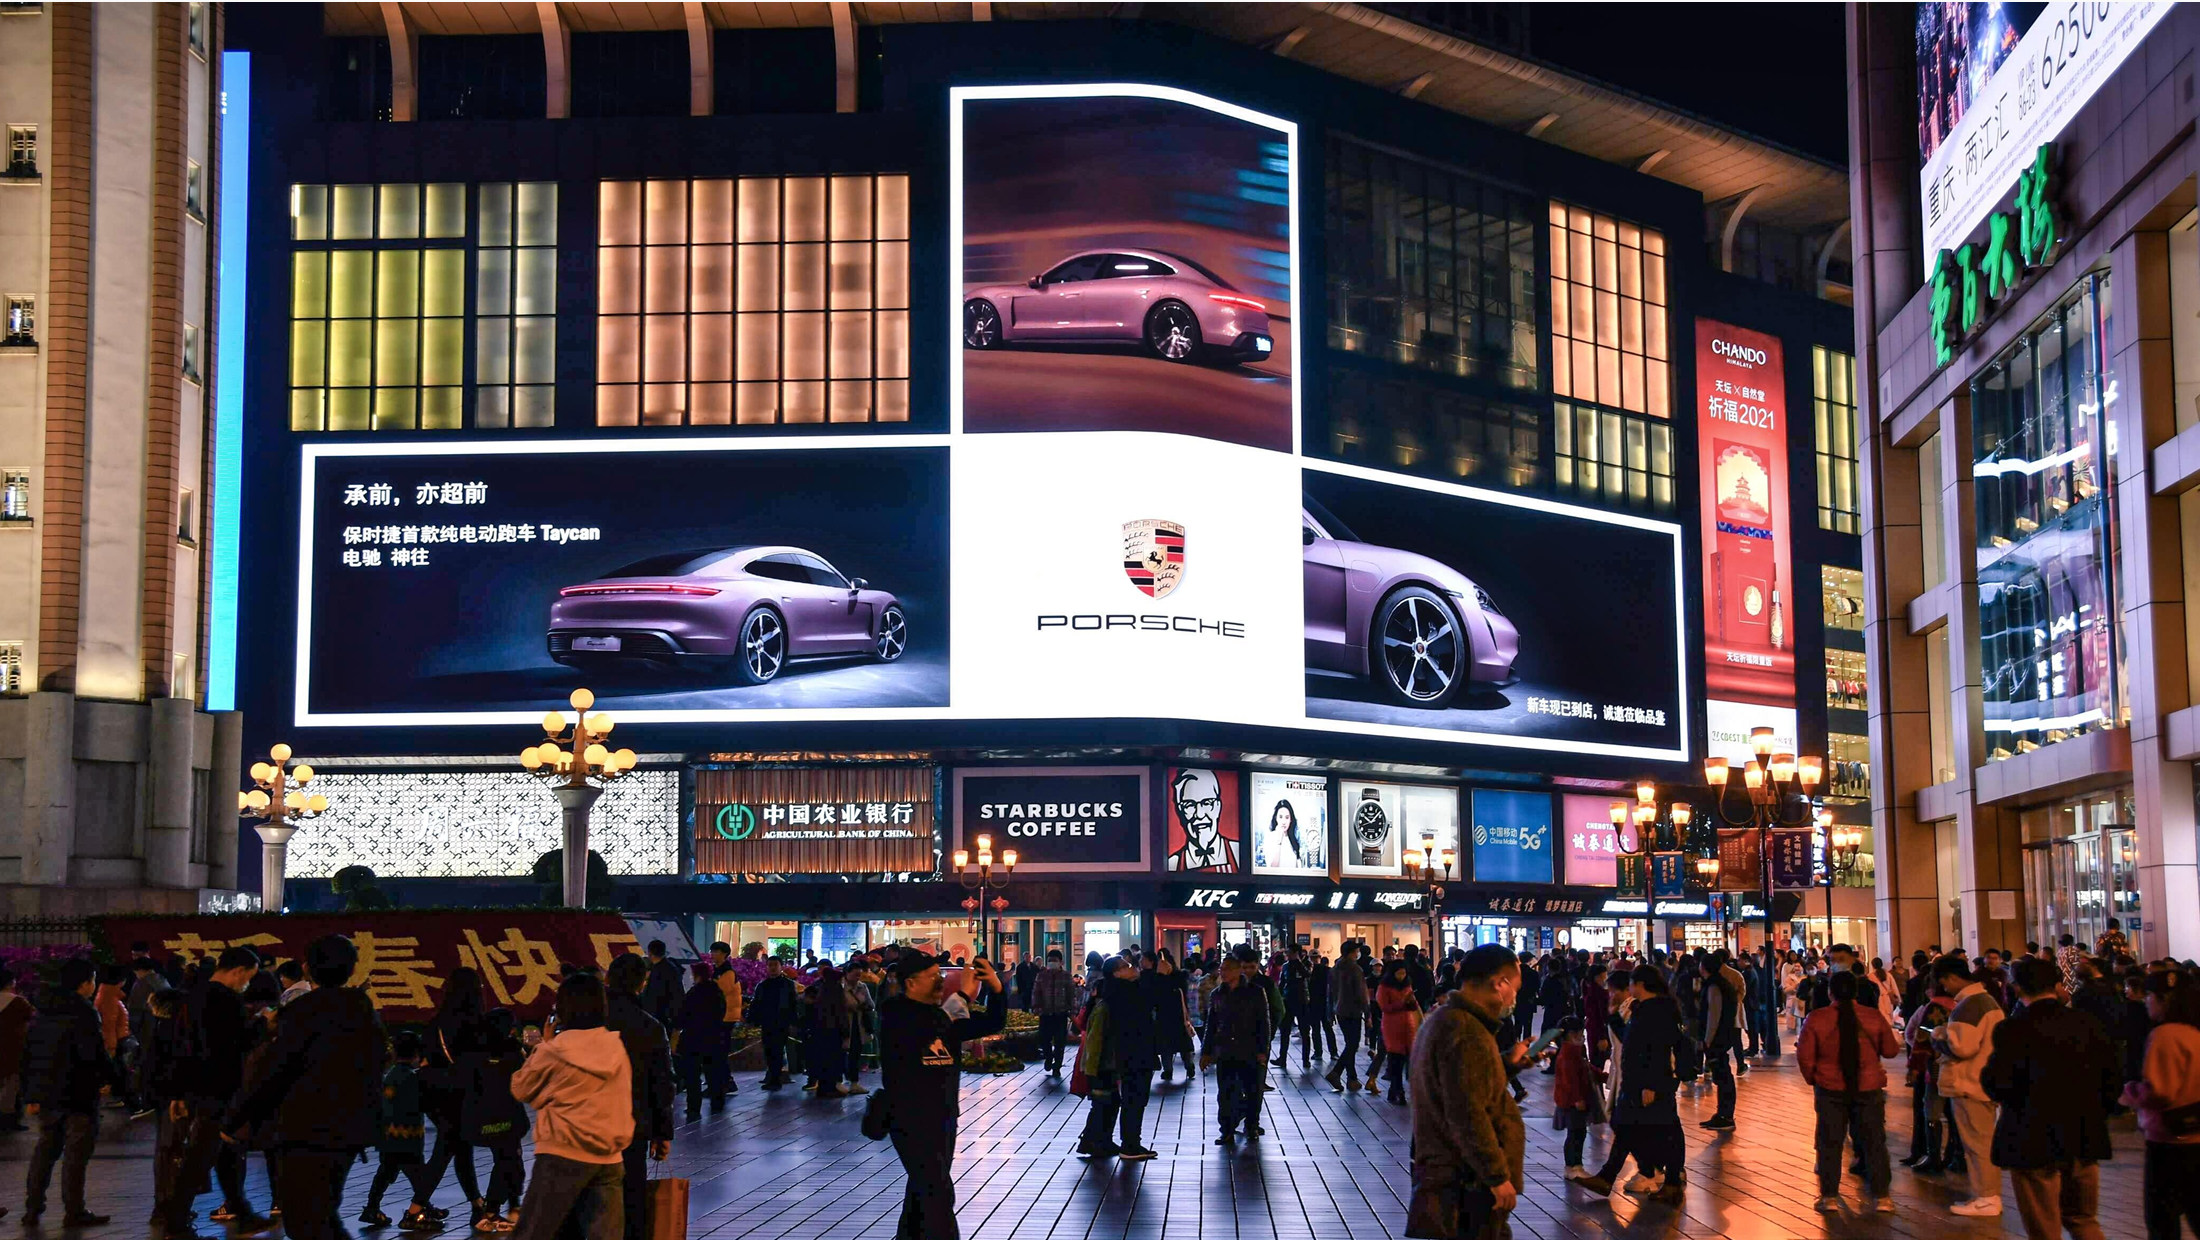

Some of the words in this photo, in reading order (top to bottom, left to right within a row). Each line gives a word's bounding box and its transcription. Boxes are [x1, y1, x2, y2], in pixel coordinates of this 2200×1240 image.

[1711, 338, 1767, 366] CHANDO
[1708, 394, 1775, 431] 祈福2021
[344, 481, 488, 507] 承前，亦超前
[343, 524, 537, 545] 保时捷首款纯电动跑车
[540, 524, 601, 545] Taycan
[1122, 519, 1184, 534] PORSCHE
[343, 548, 381, 567] 电驰
[391, 547, 430, 567] 神往
[1037, 614, 1245, 639] PORSCHE
[1299, 782, 1325, 791] TISSOT
[763, 802, 914, 826] 中国农业银行
[980, 802, 1123, 820] STARBUCKS
[416, 805, 545, 843] 周六福
[1007, 821, 1097, 837] COFFEE
[1489, 826, 1518, 838] 中国移动
[1586, 821, 1616, 831] CHENGTA
[764, 830, 836, 839] AGRICULTURAL
[838, 830, 866, 838] BANK
[868, 830, 880, 838] OF
[883, 830, 913, 838] CHINA
[1489, 837, 1503, 845] China
[1503, 838, 1518, 846] Mobile
[1184, 889, 1240, 909] KFC
[1272, 894, 1315, 905] TISSOT
